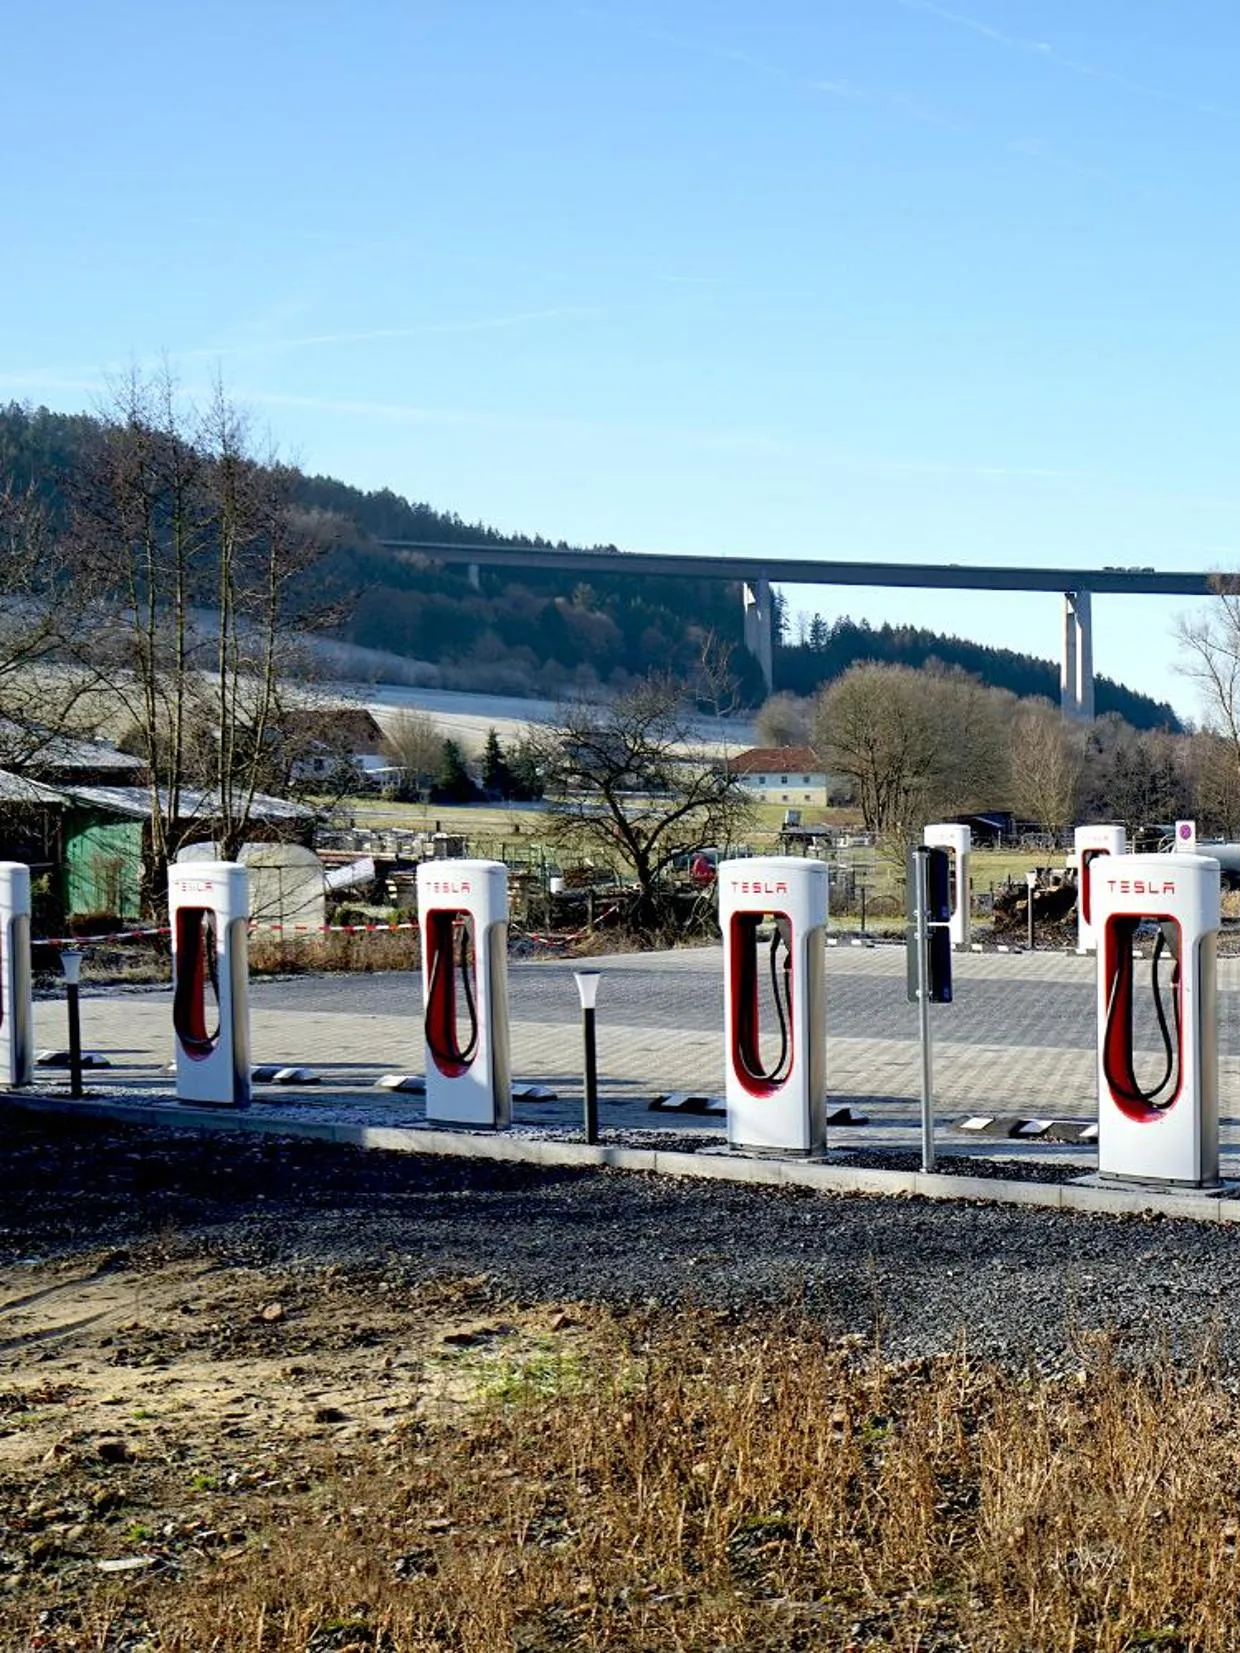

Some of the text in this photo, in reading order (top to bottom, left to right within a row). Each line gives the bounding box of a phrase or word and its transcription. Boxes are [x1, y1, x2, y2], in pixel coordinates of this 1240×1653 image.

[174, 882, 213, 893] TESLA
[425, 881, 471, 894] TESLA
[731, 882, 788, 894] TESLA
[1107, 880, 1176, 895] TESLA
